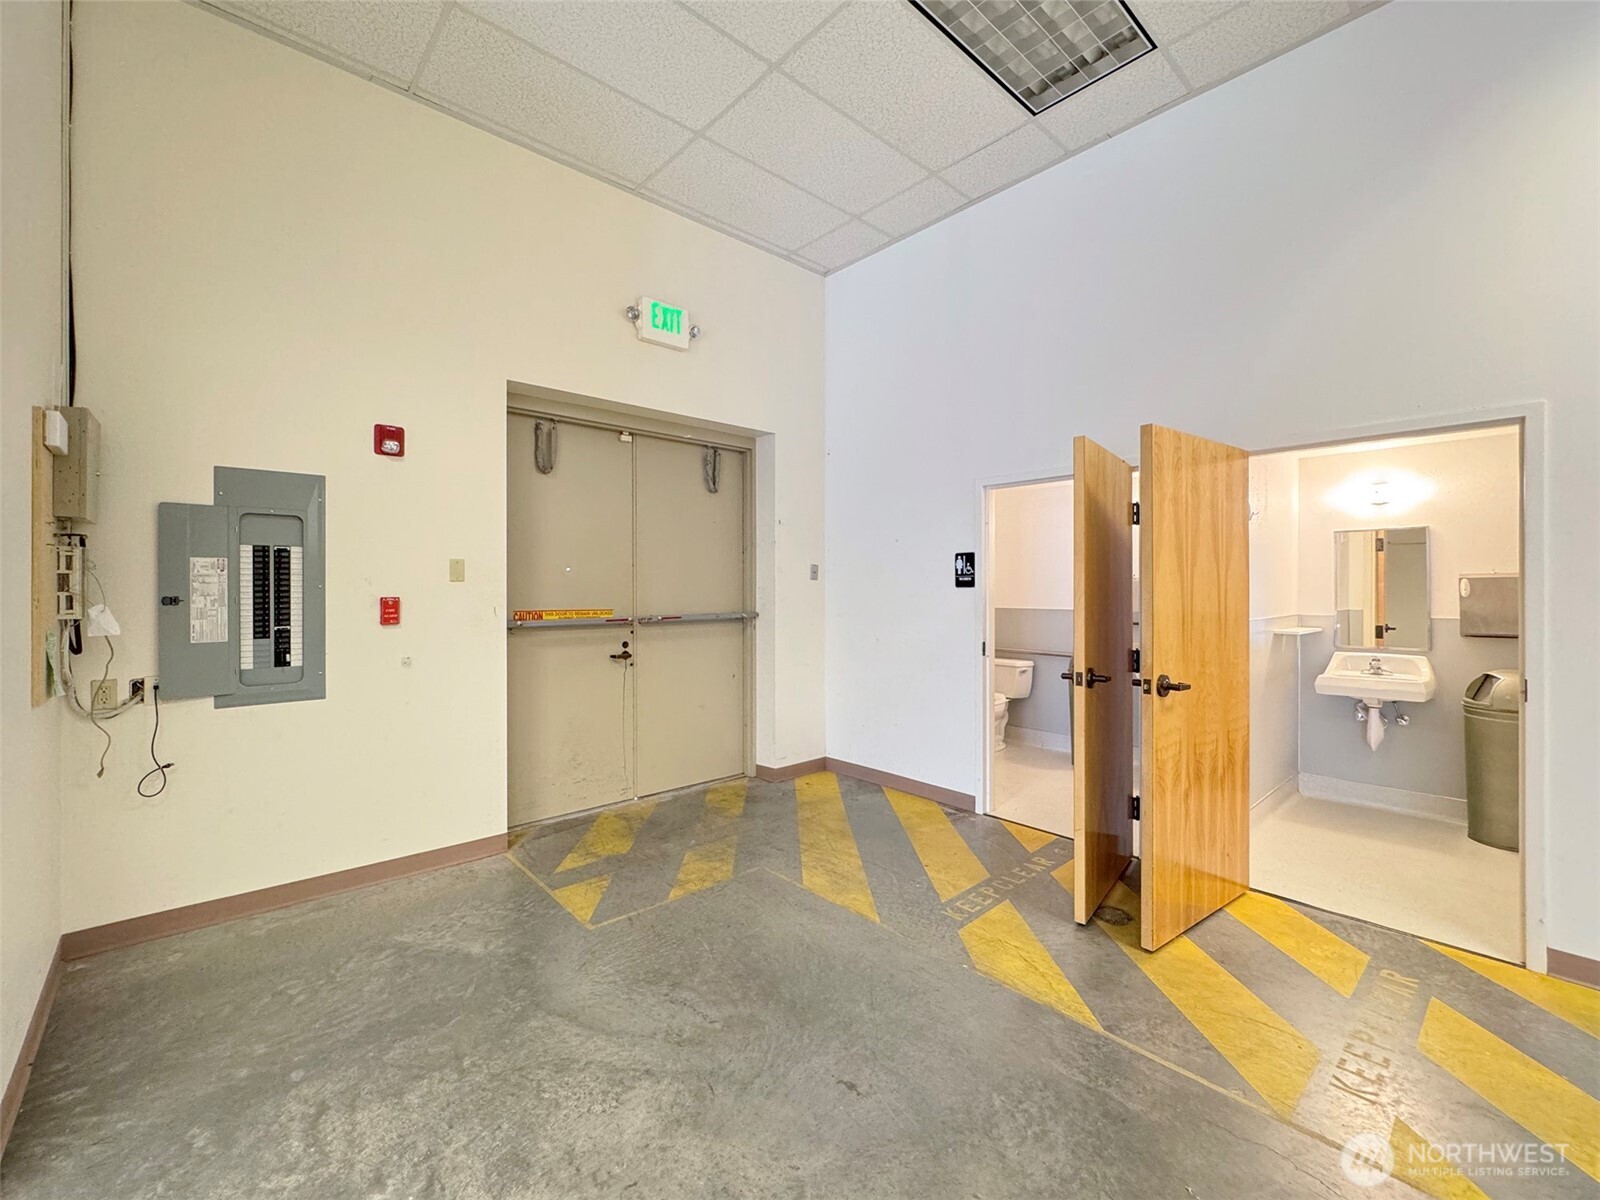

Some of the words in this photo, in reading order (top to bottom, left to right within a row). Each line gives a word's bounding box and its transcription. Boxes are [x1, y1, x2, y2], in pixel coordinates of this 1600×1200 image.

[651, 301, 683, 335] EXIT
[513, 611, 544, 622] CAUTION
[940, 886, 1000, 921] KEEP
[992, 856, 1056, 890] CLEAR
[1328, 1029, 1396, 1107] KEEP
